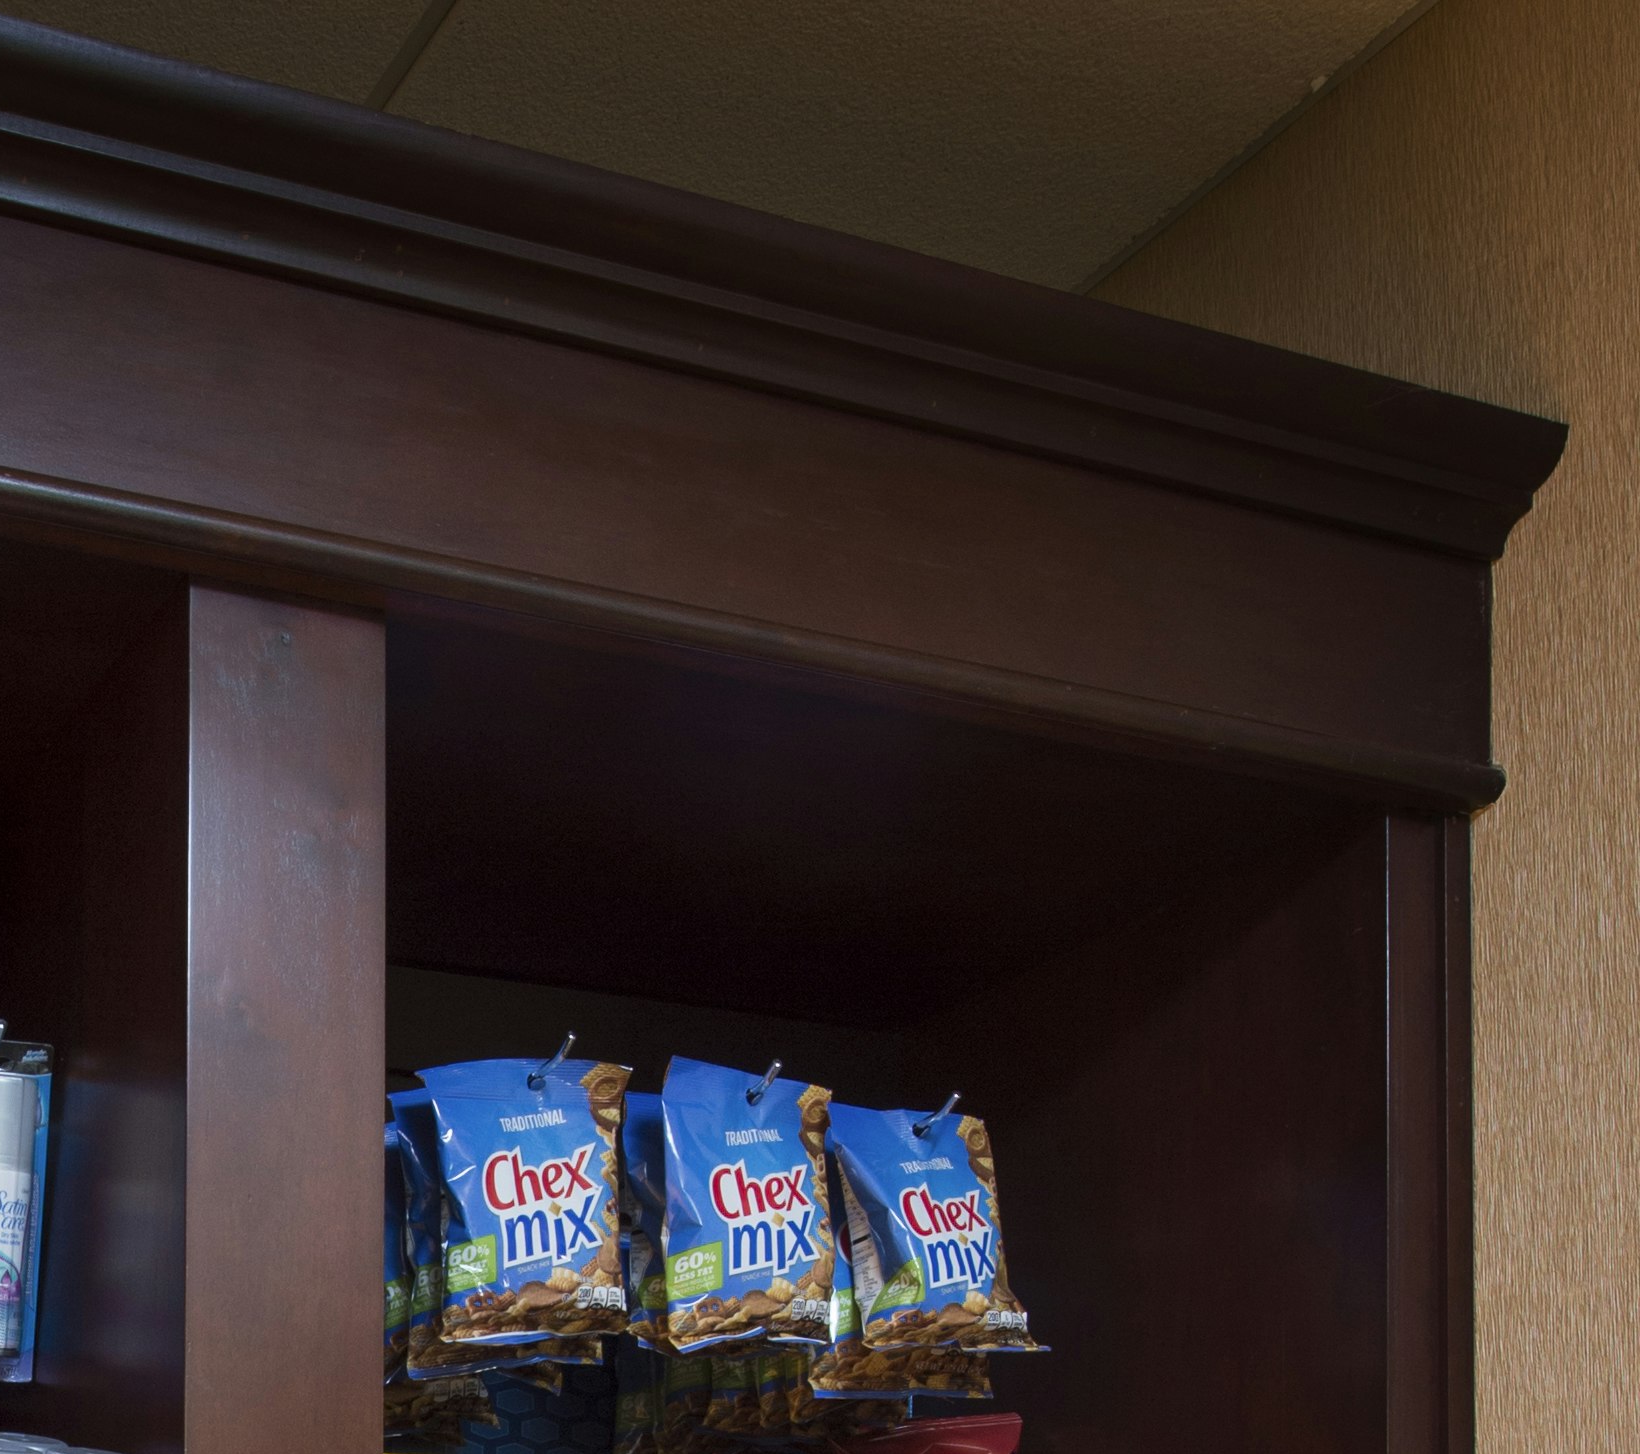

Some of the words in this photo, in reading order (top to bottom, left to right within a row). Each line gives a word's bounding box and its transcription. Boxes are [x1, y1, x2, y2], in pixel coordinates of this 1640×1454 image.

[499, 1108, 567, 1132] TRADITIONAL
[725, 1129, 783, 1146] TRADITIONAL
[484, 1149, 594, 1211] Chex
[711, 1168, 809, 1220] Chex
[504, 1194, 599, 1263] mix
[901, 1189, 987, 1237] Chex
[732, 1211, 815, 1271] mix
[927, 1232, 996, 1284] mix
